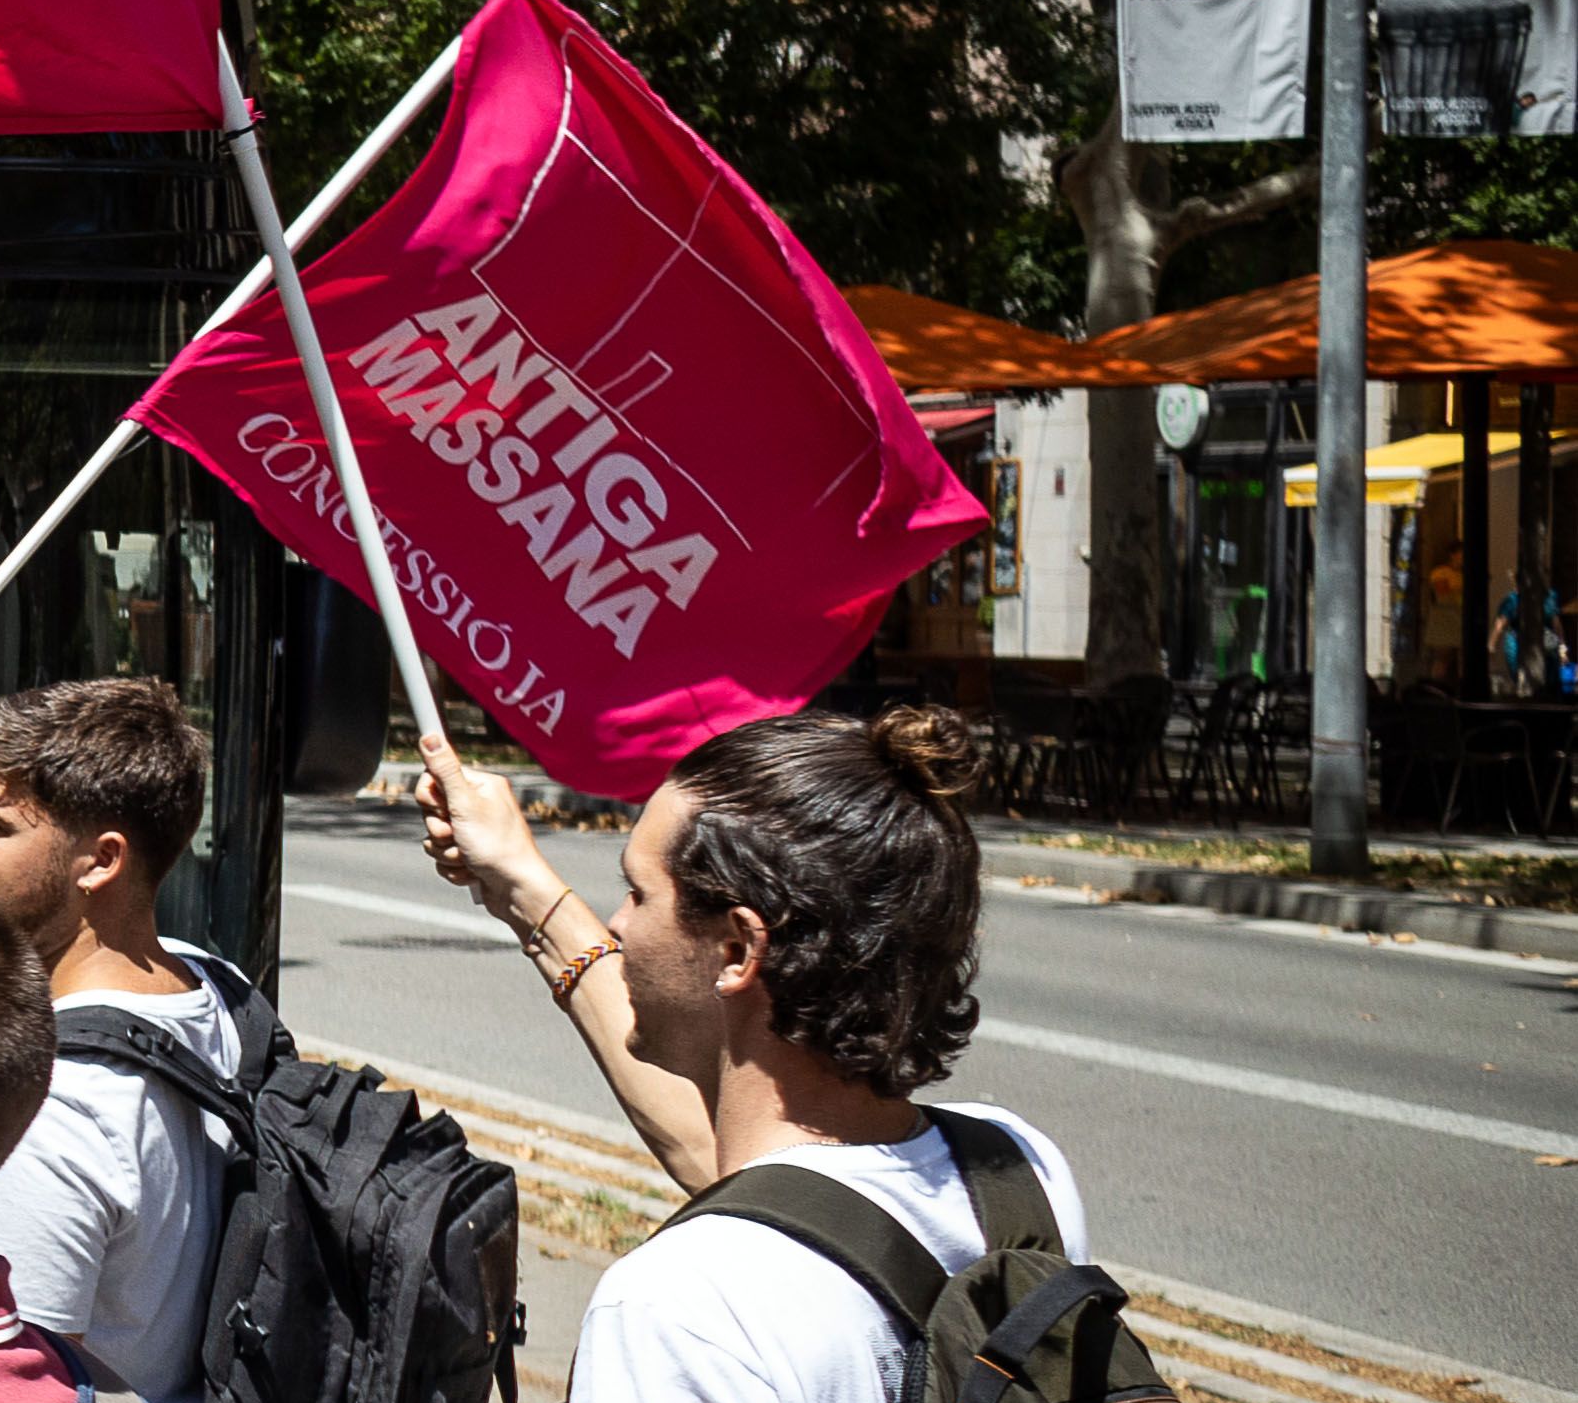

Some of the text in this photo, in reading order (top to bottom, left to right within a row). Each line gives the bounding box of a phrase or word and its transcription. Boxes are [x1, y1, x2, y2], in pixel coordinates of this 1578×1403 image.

[348, 317, 660, 660] MASSANA
[413, 292, 719, 611] ANTIGA
[493, 659, 566, 738] JA
